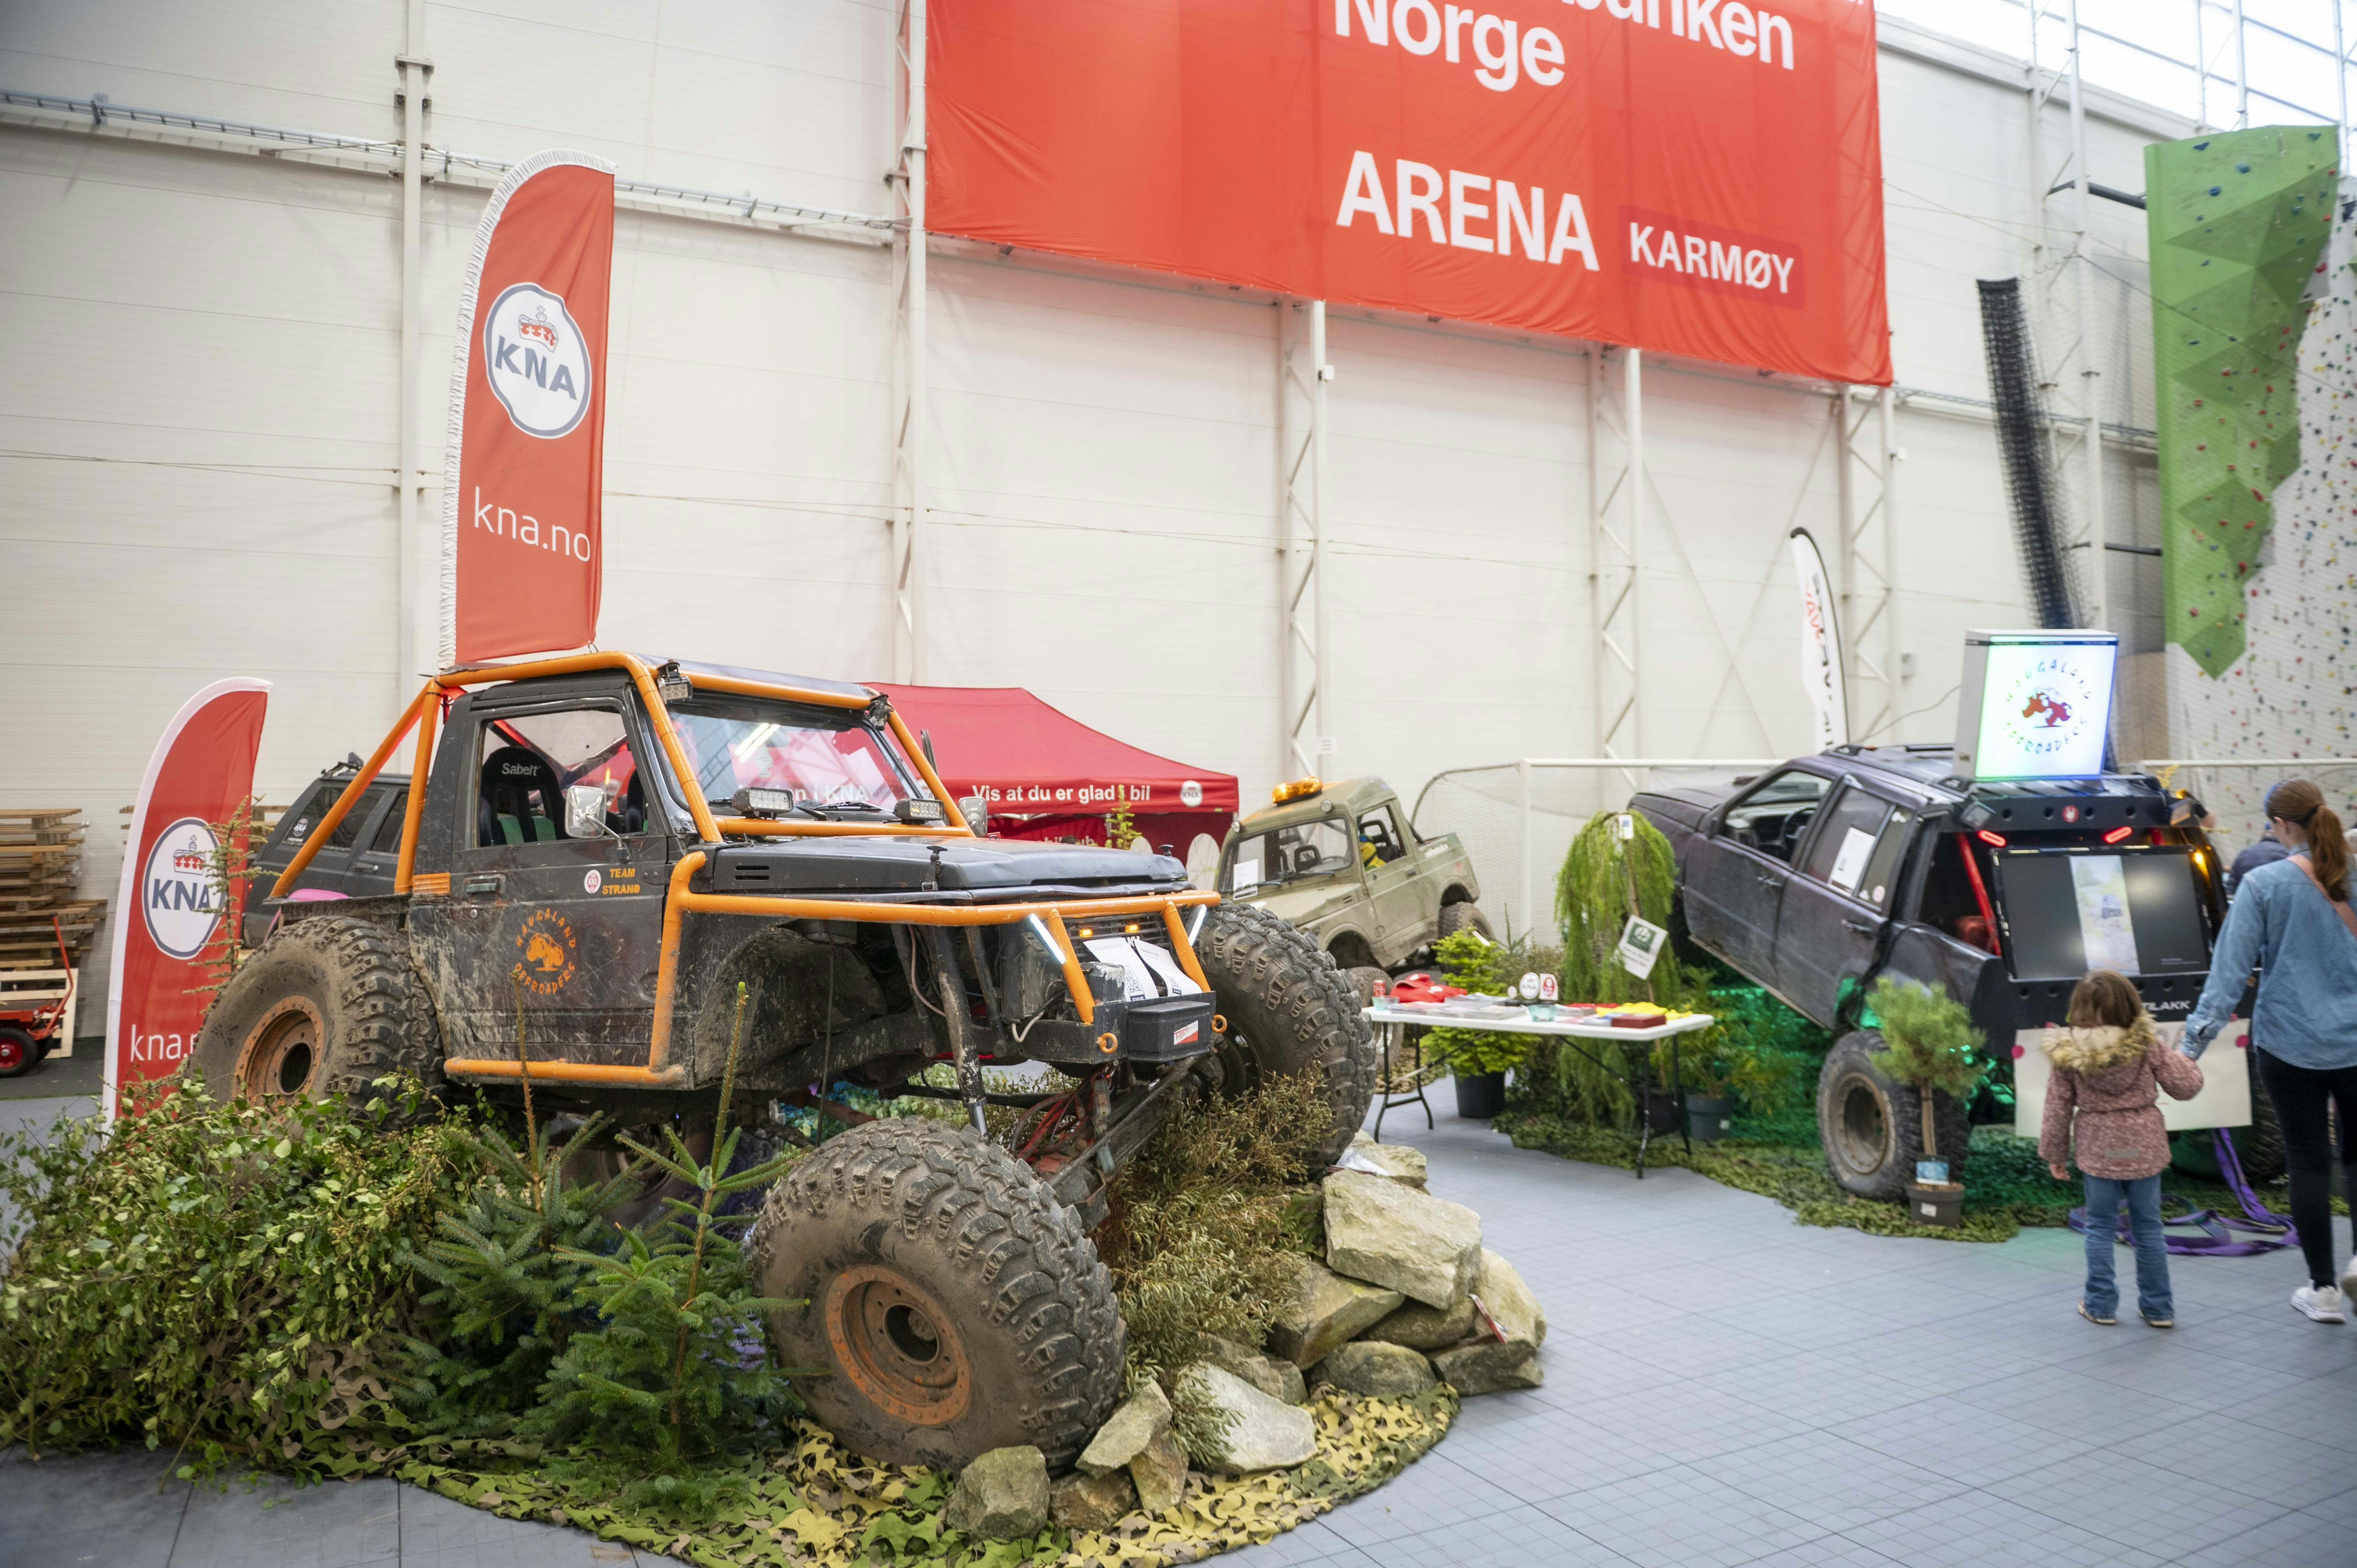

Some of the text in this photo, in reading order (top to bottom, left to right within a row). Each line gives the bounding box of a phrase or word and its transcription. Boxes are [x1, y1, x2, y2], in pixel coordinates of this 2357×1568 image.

[1334, 0, 1565, 92] Norge
[1336, 150, 1795, 294] ARENA KARMØY
[495, 335, 578, 401] KNA
[474, 486, 592, 563] kna.no
[501, 762, 539, 777] Sabelt
[972, 785, 1001, 802] Vis
[1006, 786, 1024, 801] at
[1028, 785, 1051, 801] du
[1055, 787, 1074, 801] er
[1078, 784, 1115, 804] glad
[1130, 784, 1151, 801] bil
[602, 883, 641, 895] STRAND
[609, 867, 636, 878] TEAM
[152, 878, 211, 912] KNA
